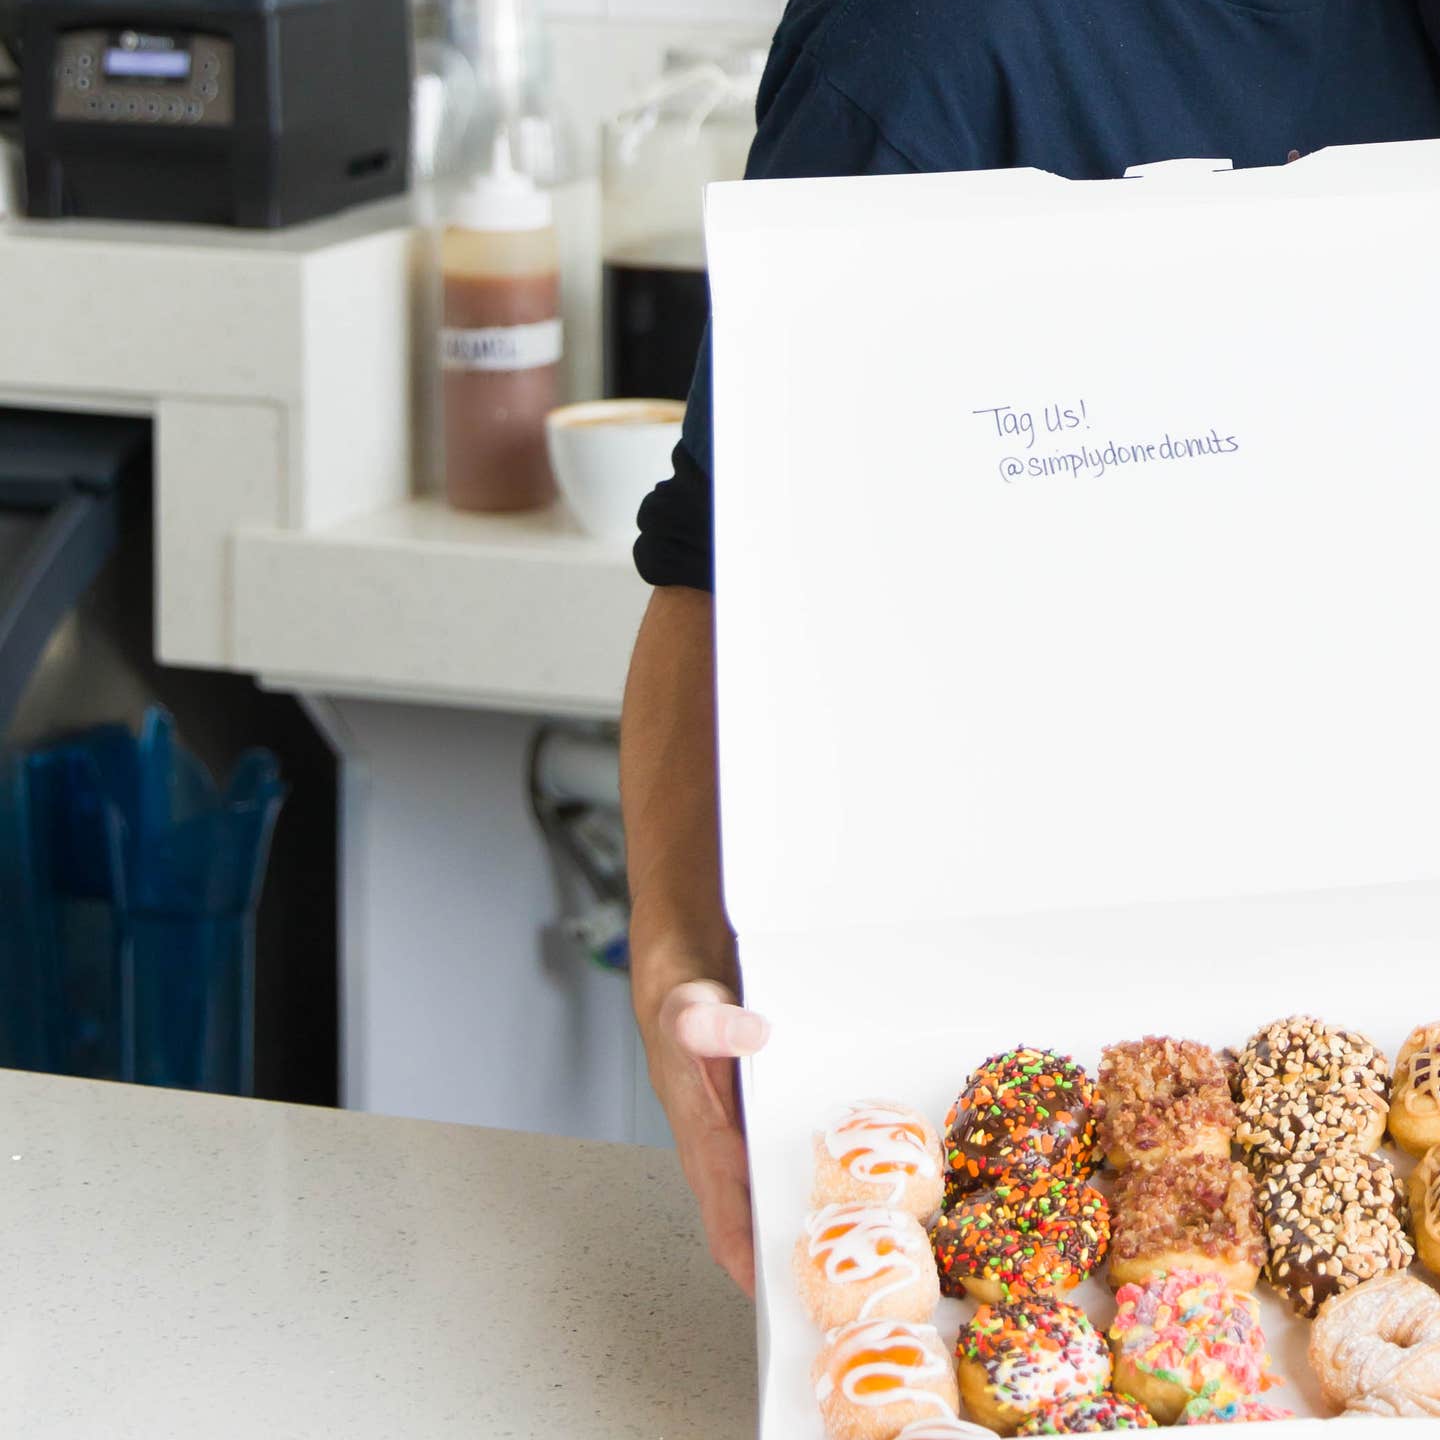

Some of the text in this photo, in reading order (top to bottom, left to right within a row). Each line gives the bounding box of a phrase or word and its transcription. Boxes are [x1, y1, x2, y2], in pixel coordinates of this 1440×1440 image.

[972, 399, 1091, 449] Tag Us!
[999, 429, 1239, 484] @simplydonedonuts
